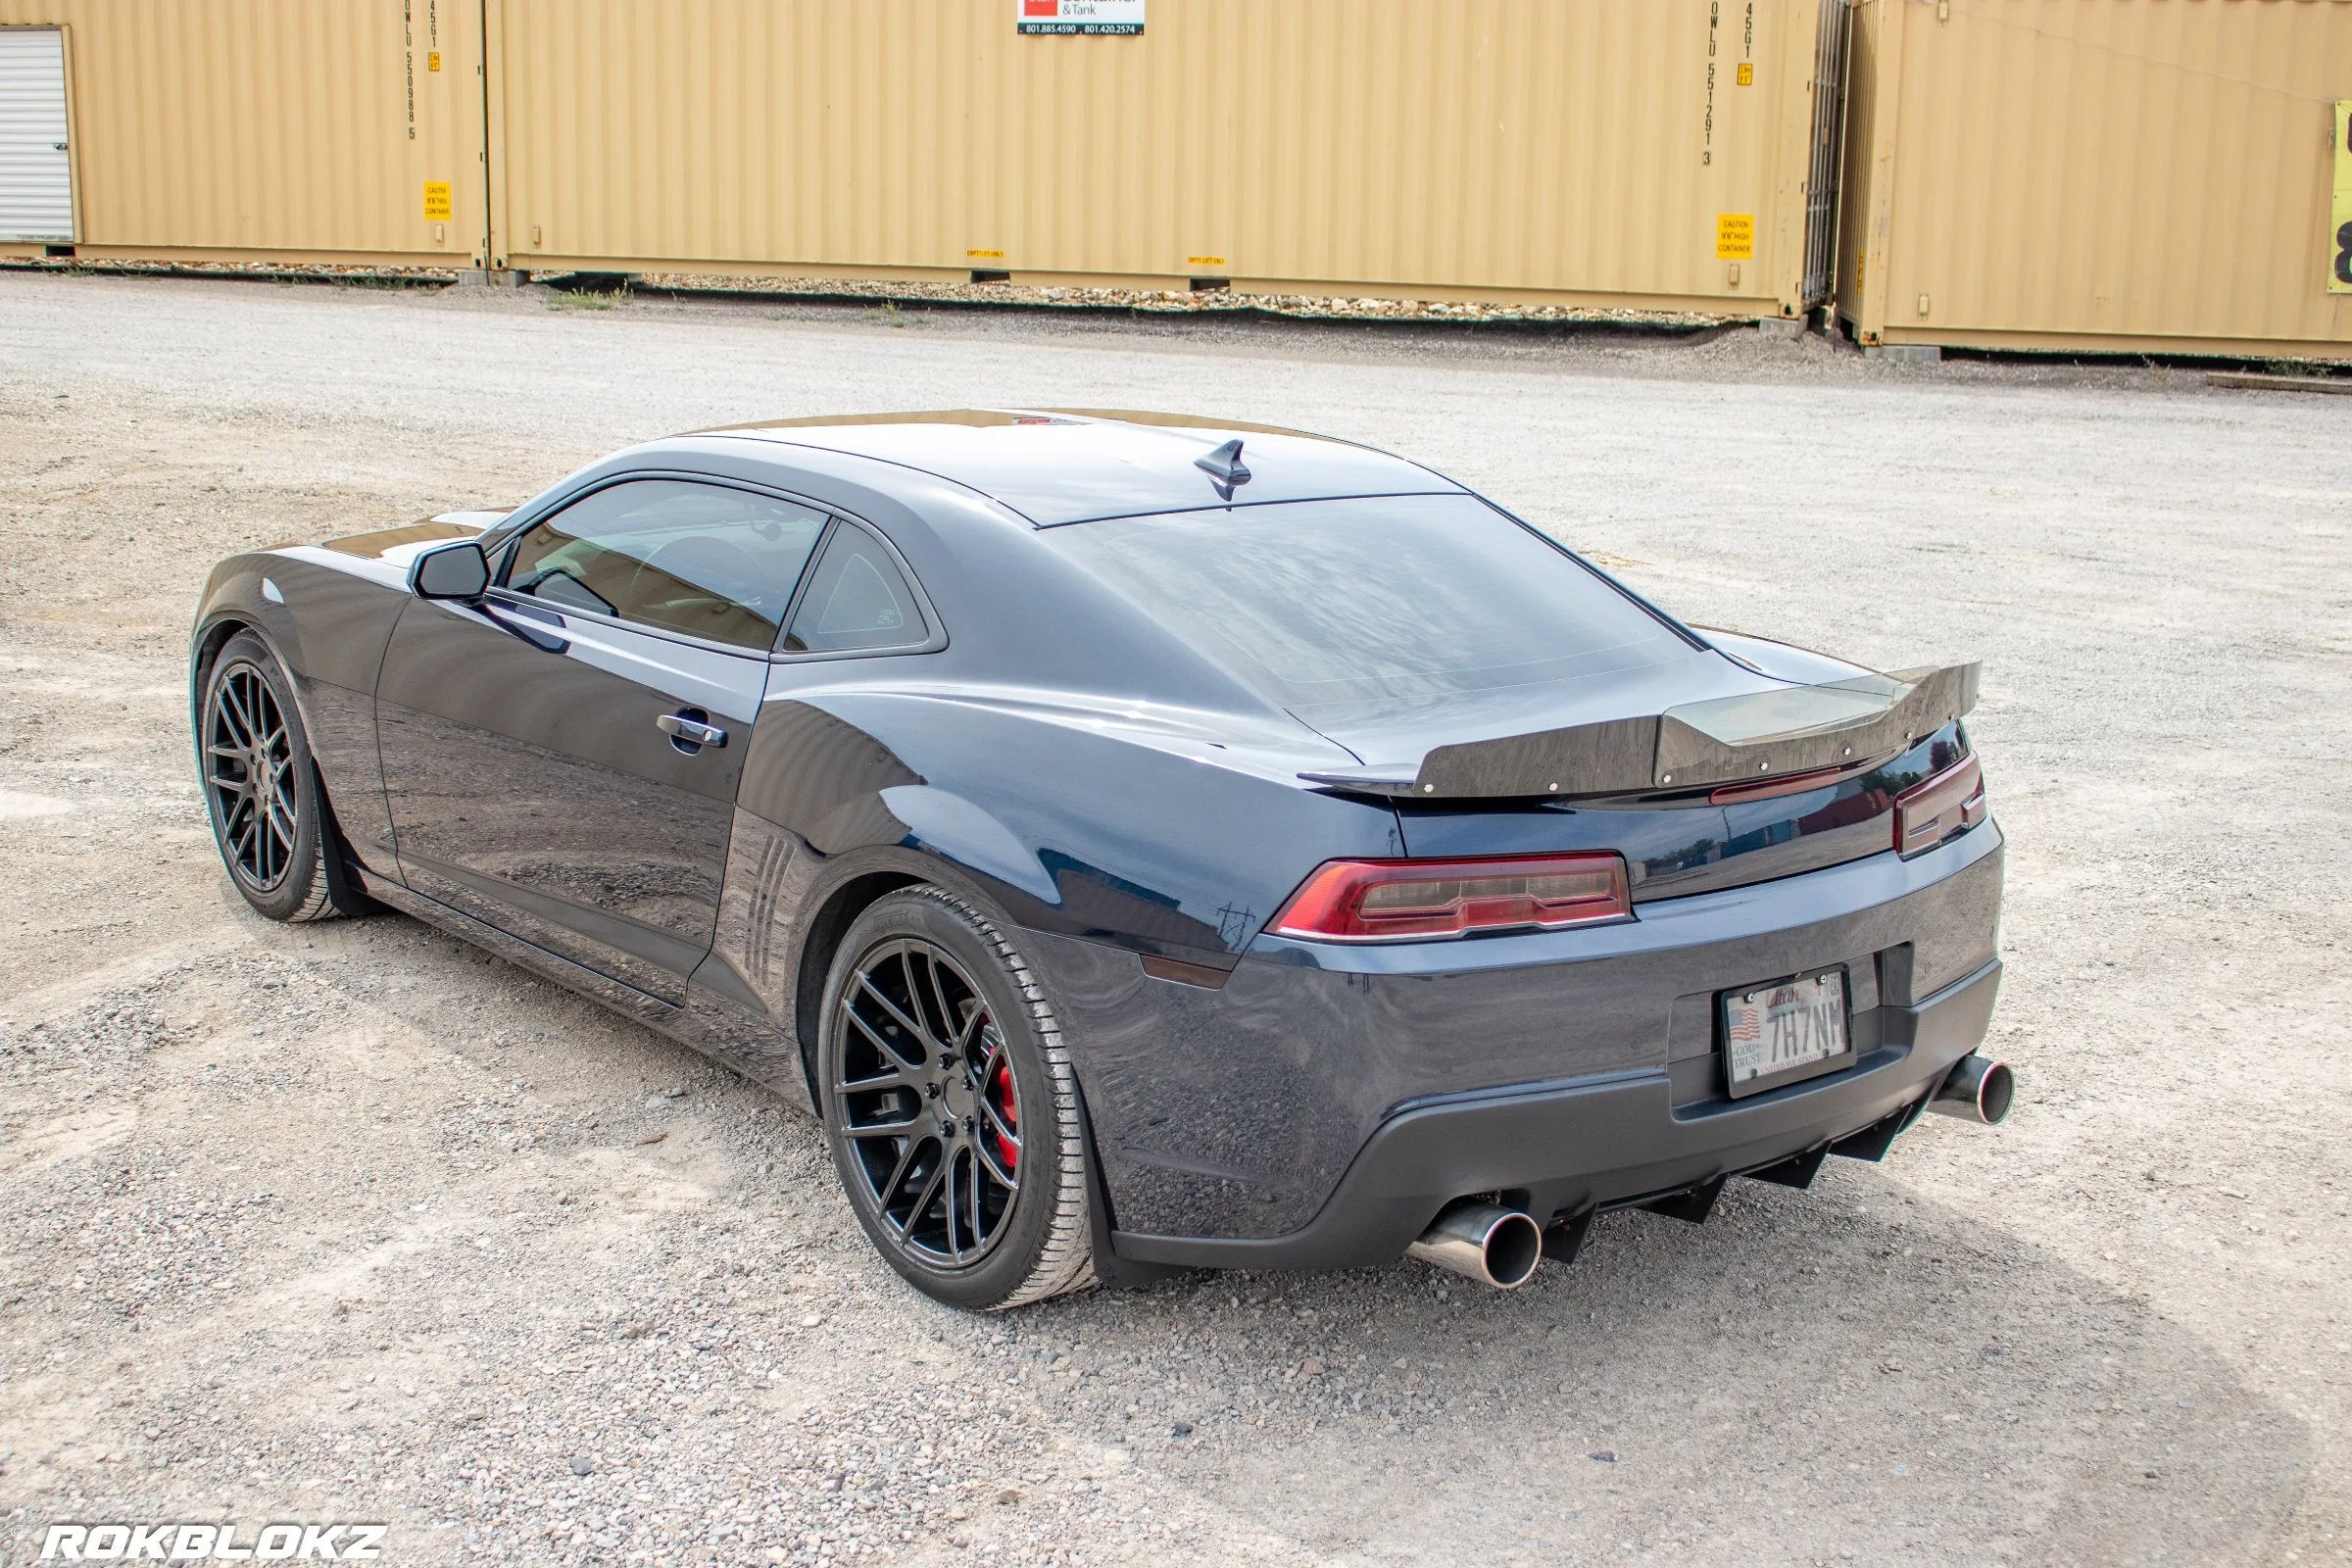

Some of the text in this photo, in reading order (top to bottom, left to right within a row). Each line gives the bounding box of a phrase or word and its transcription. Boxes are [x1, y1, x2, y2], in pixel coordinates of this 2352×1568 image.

[1062, 4, 1097, 16] & Tank
[1026, 24, 1135, 33] 801.885.4590 801.420.2574
[1703, 1, 1718, 165] OWLU 551291 3
[409, 127, 416, 140] 5
[1723, 220, 1748, 228] CAUTION
[1717, 243, 1750, 254] CONTAINER
[1766, 987, 1799, 1008] Utah
[1766, 999, 1844, 1062] 7H7NM
[1734, 1053, 1761, 1068] TRUST
[1760, 1061, 1786, 1075] UNITED
